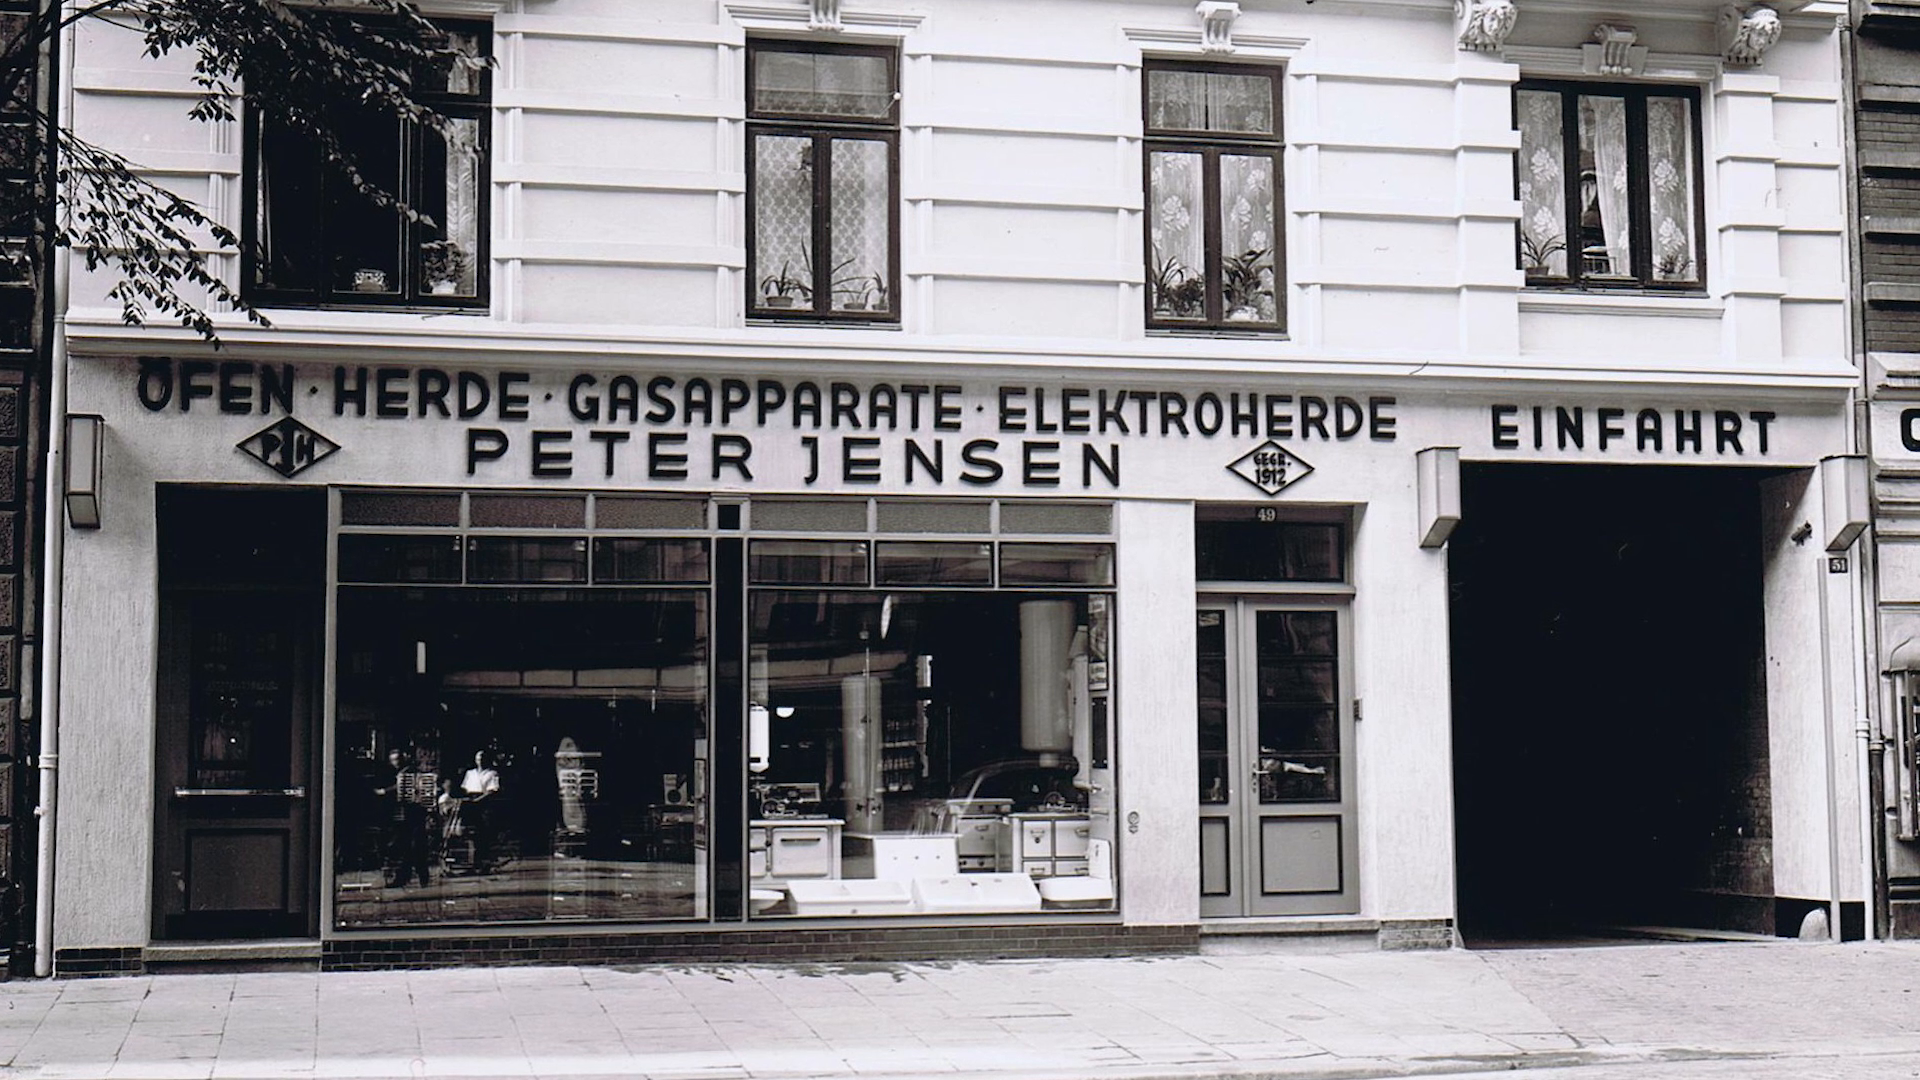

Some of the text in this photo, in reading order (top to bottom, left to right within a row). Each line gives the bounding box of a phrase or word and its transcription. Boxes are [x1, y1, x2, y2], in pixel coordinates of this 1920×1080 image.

[138, 356, 1398, 440] ÖFEN HERDE GASAPPARATE ELEKTROHERDE
[1491, 404, 1778, 455] EINFAHRT
[468, 428, 1120, 488] PETER JENSEN
[1255, 468, 1287, 487] 1912
[1257, 507, 1276, 522] 49
[1831, 559, 1847, 571] 51
